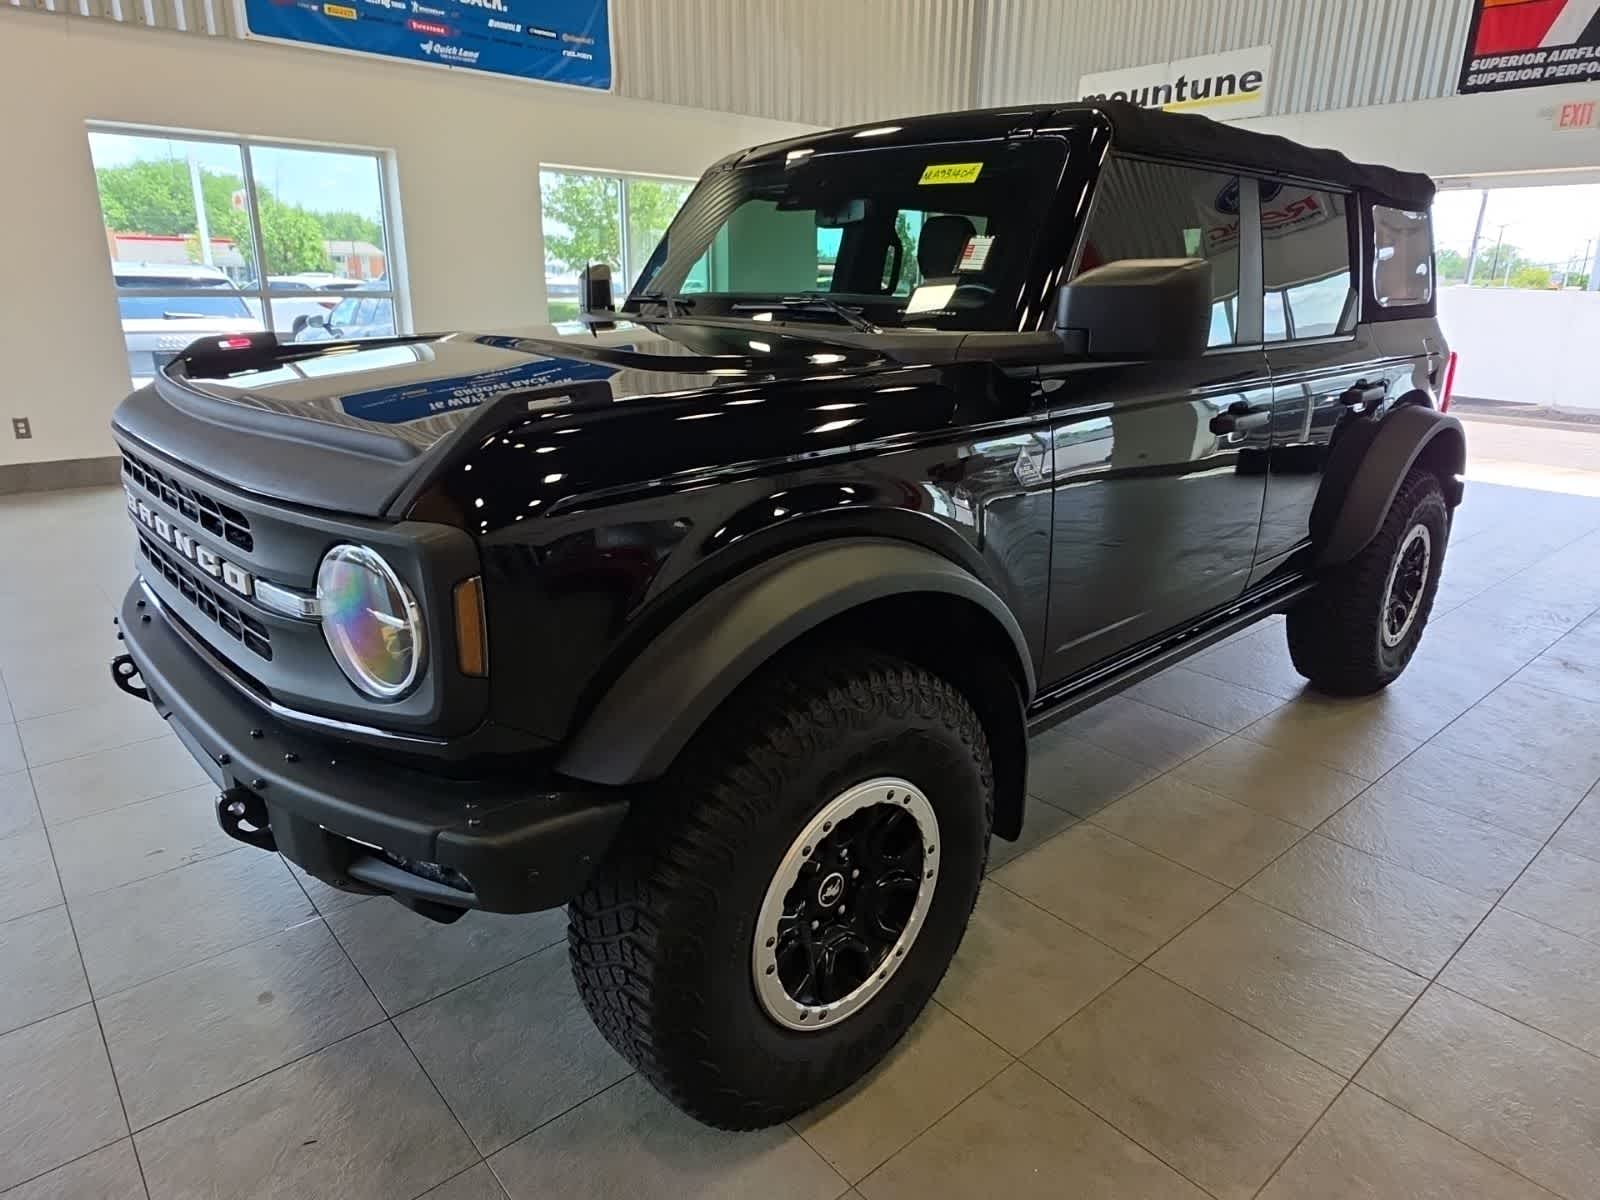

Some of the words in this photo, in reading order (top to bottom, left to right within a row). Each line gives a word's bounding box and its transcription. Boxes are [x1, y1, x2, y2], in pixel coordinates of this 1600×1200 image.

[433, 43, 458, 55] Quick
[458, 47, 480, 59] Lane
[1469, 52, 1547, 71] SUPERIOR
[1466, 67, 1545, 86] SUPERIOR
[1559, 103, 1595, 128] EXIT
[126, 488, 251, 597] BRONCO
